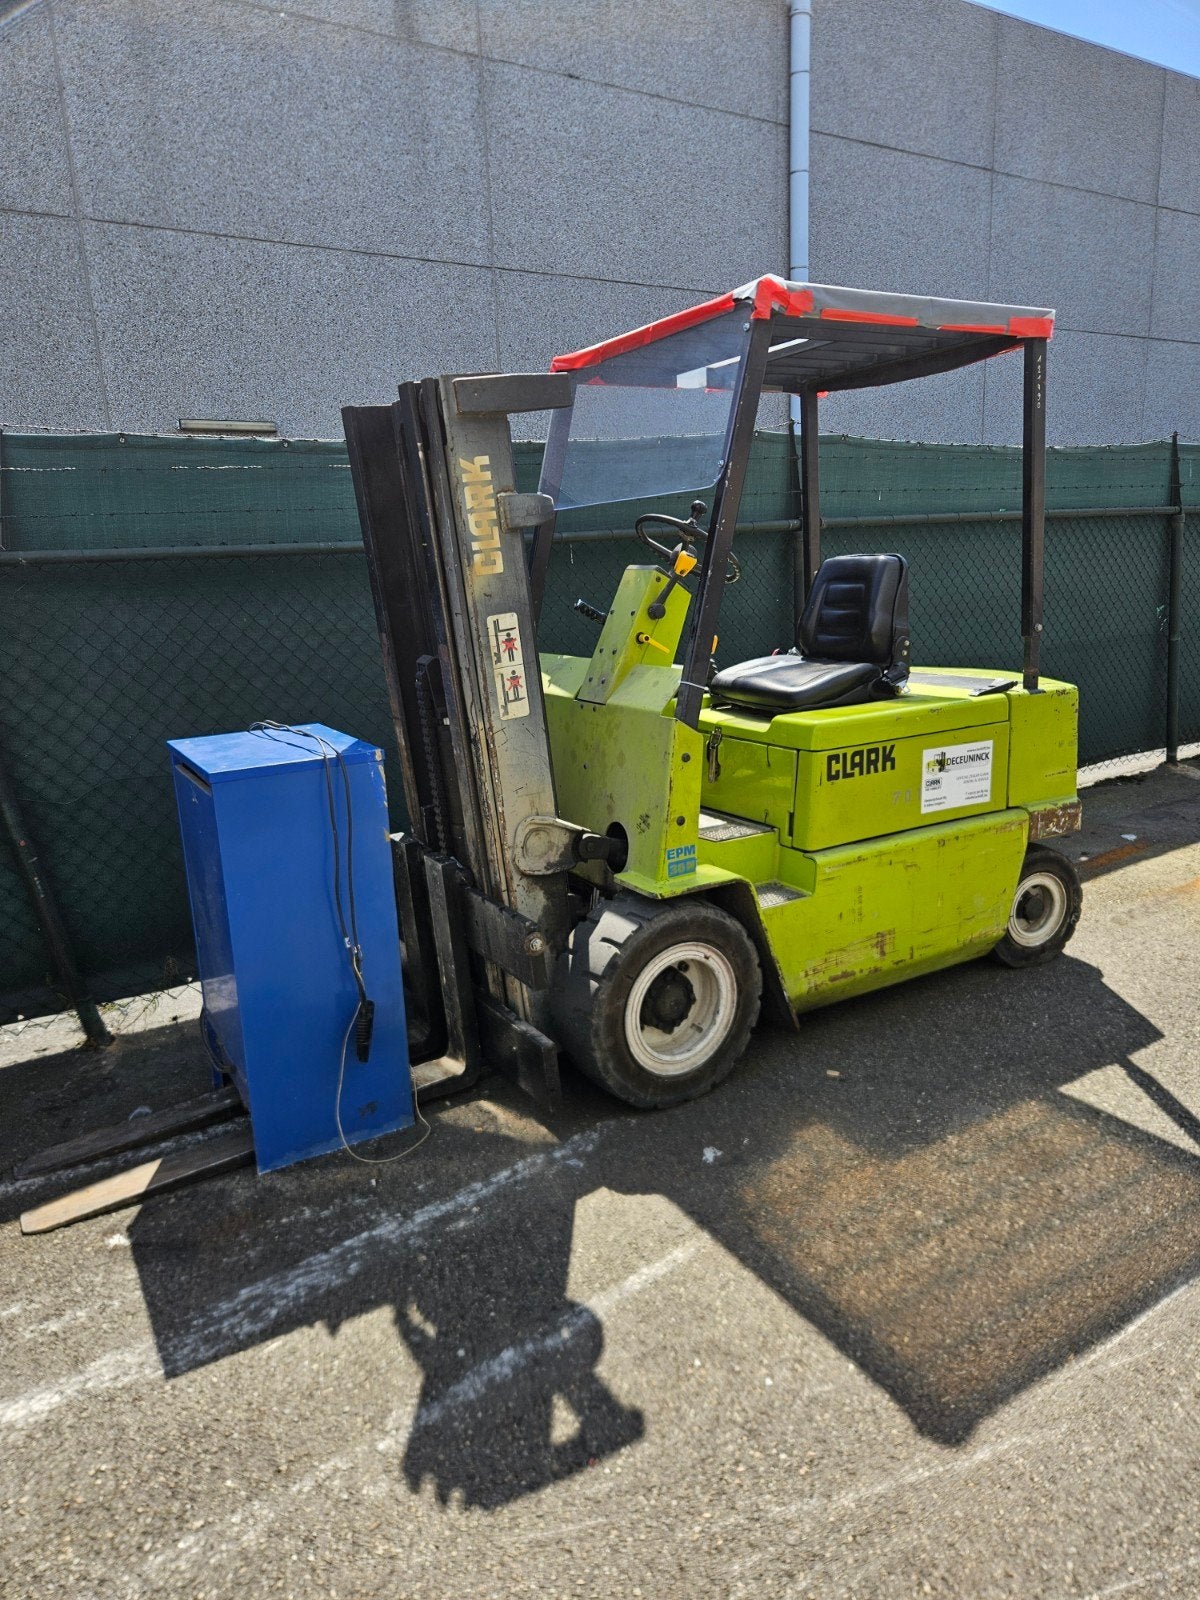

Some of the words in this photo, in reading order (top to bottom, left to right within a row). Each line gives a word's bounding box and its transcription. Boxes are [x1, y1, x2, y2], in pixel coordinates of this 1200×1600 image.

[460, 455, 504, 576] CLARK
[827, 744, 896, 782] CLARK
[946, 751, 990, 766] DECEUNINCK
[667, 844, 696, 861] EPM
